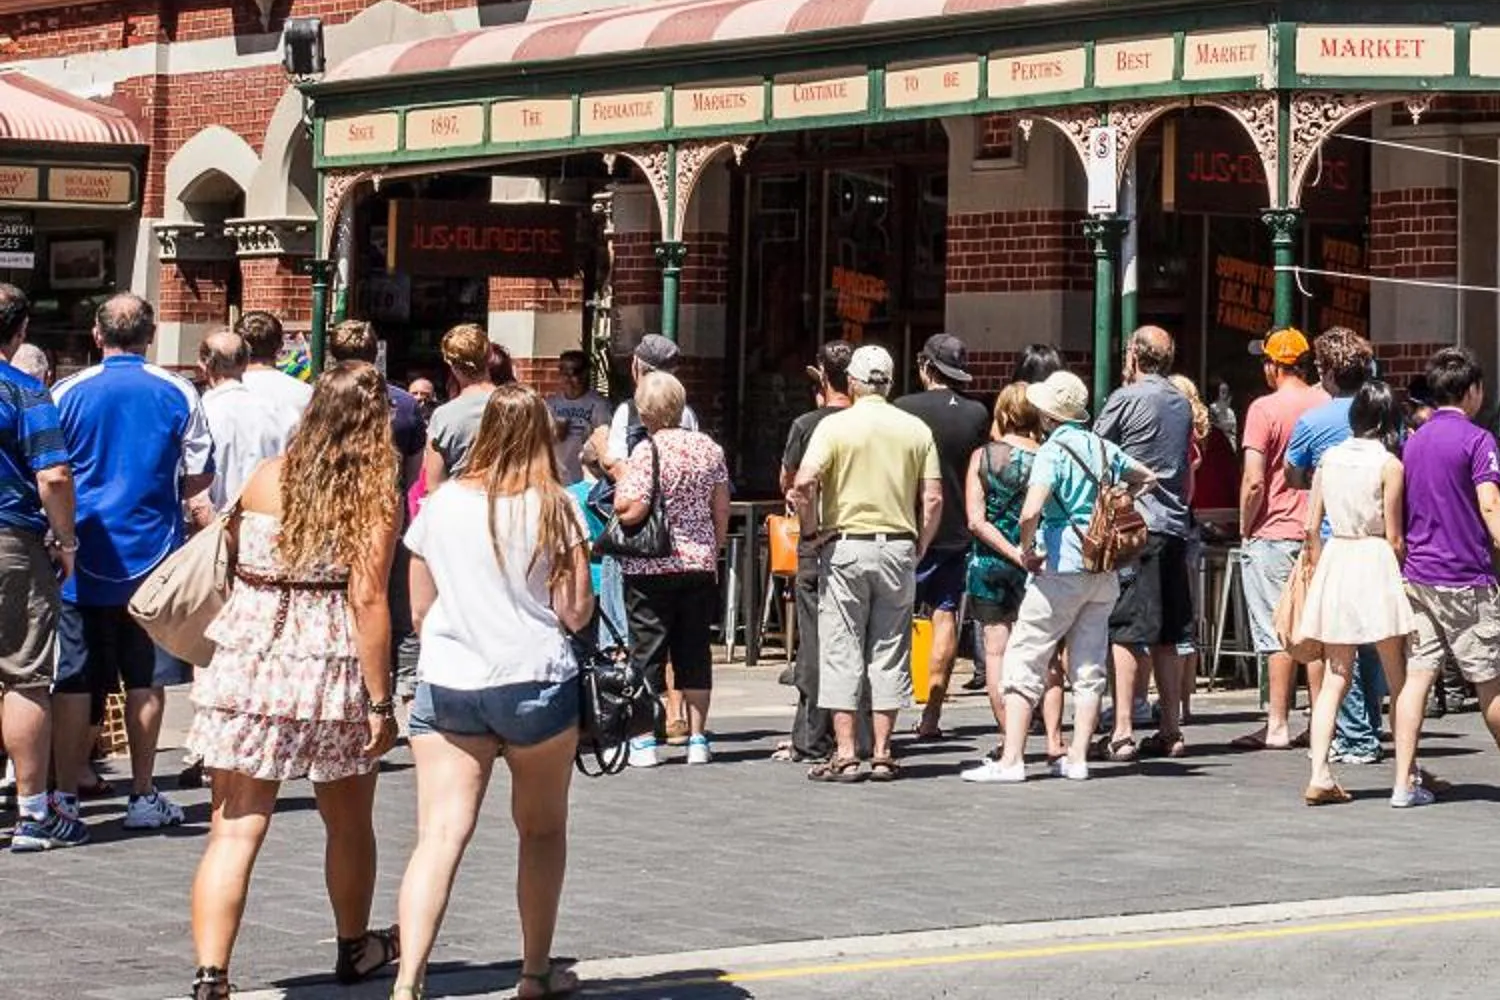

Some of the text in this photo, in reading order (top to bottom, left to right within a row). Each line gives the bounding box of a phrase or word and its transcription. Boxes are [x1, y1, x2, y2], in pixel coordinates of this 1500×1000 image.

[1195, 43, 1257, 65] MARKET
[1320, 38, 1425, 60] MARKET
[1117, 51, 1152, 71] BEST
[793, 82, 848, 102] CONTINUE
[905, 72, 960, 92] TO BE
[592, 101, 653, 121] FREMANTLE
[692, 92, 747, 112] MARKETS
